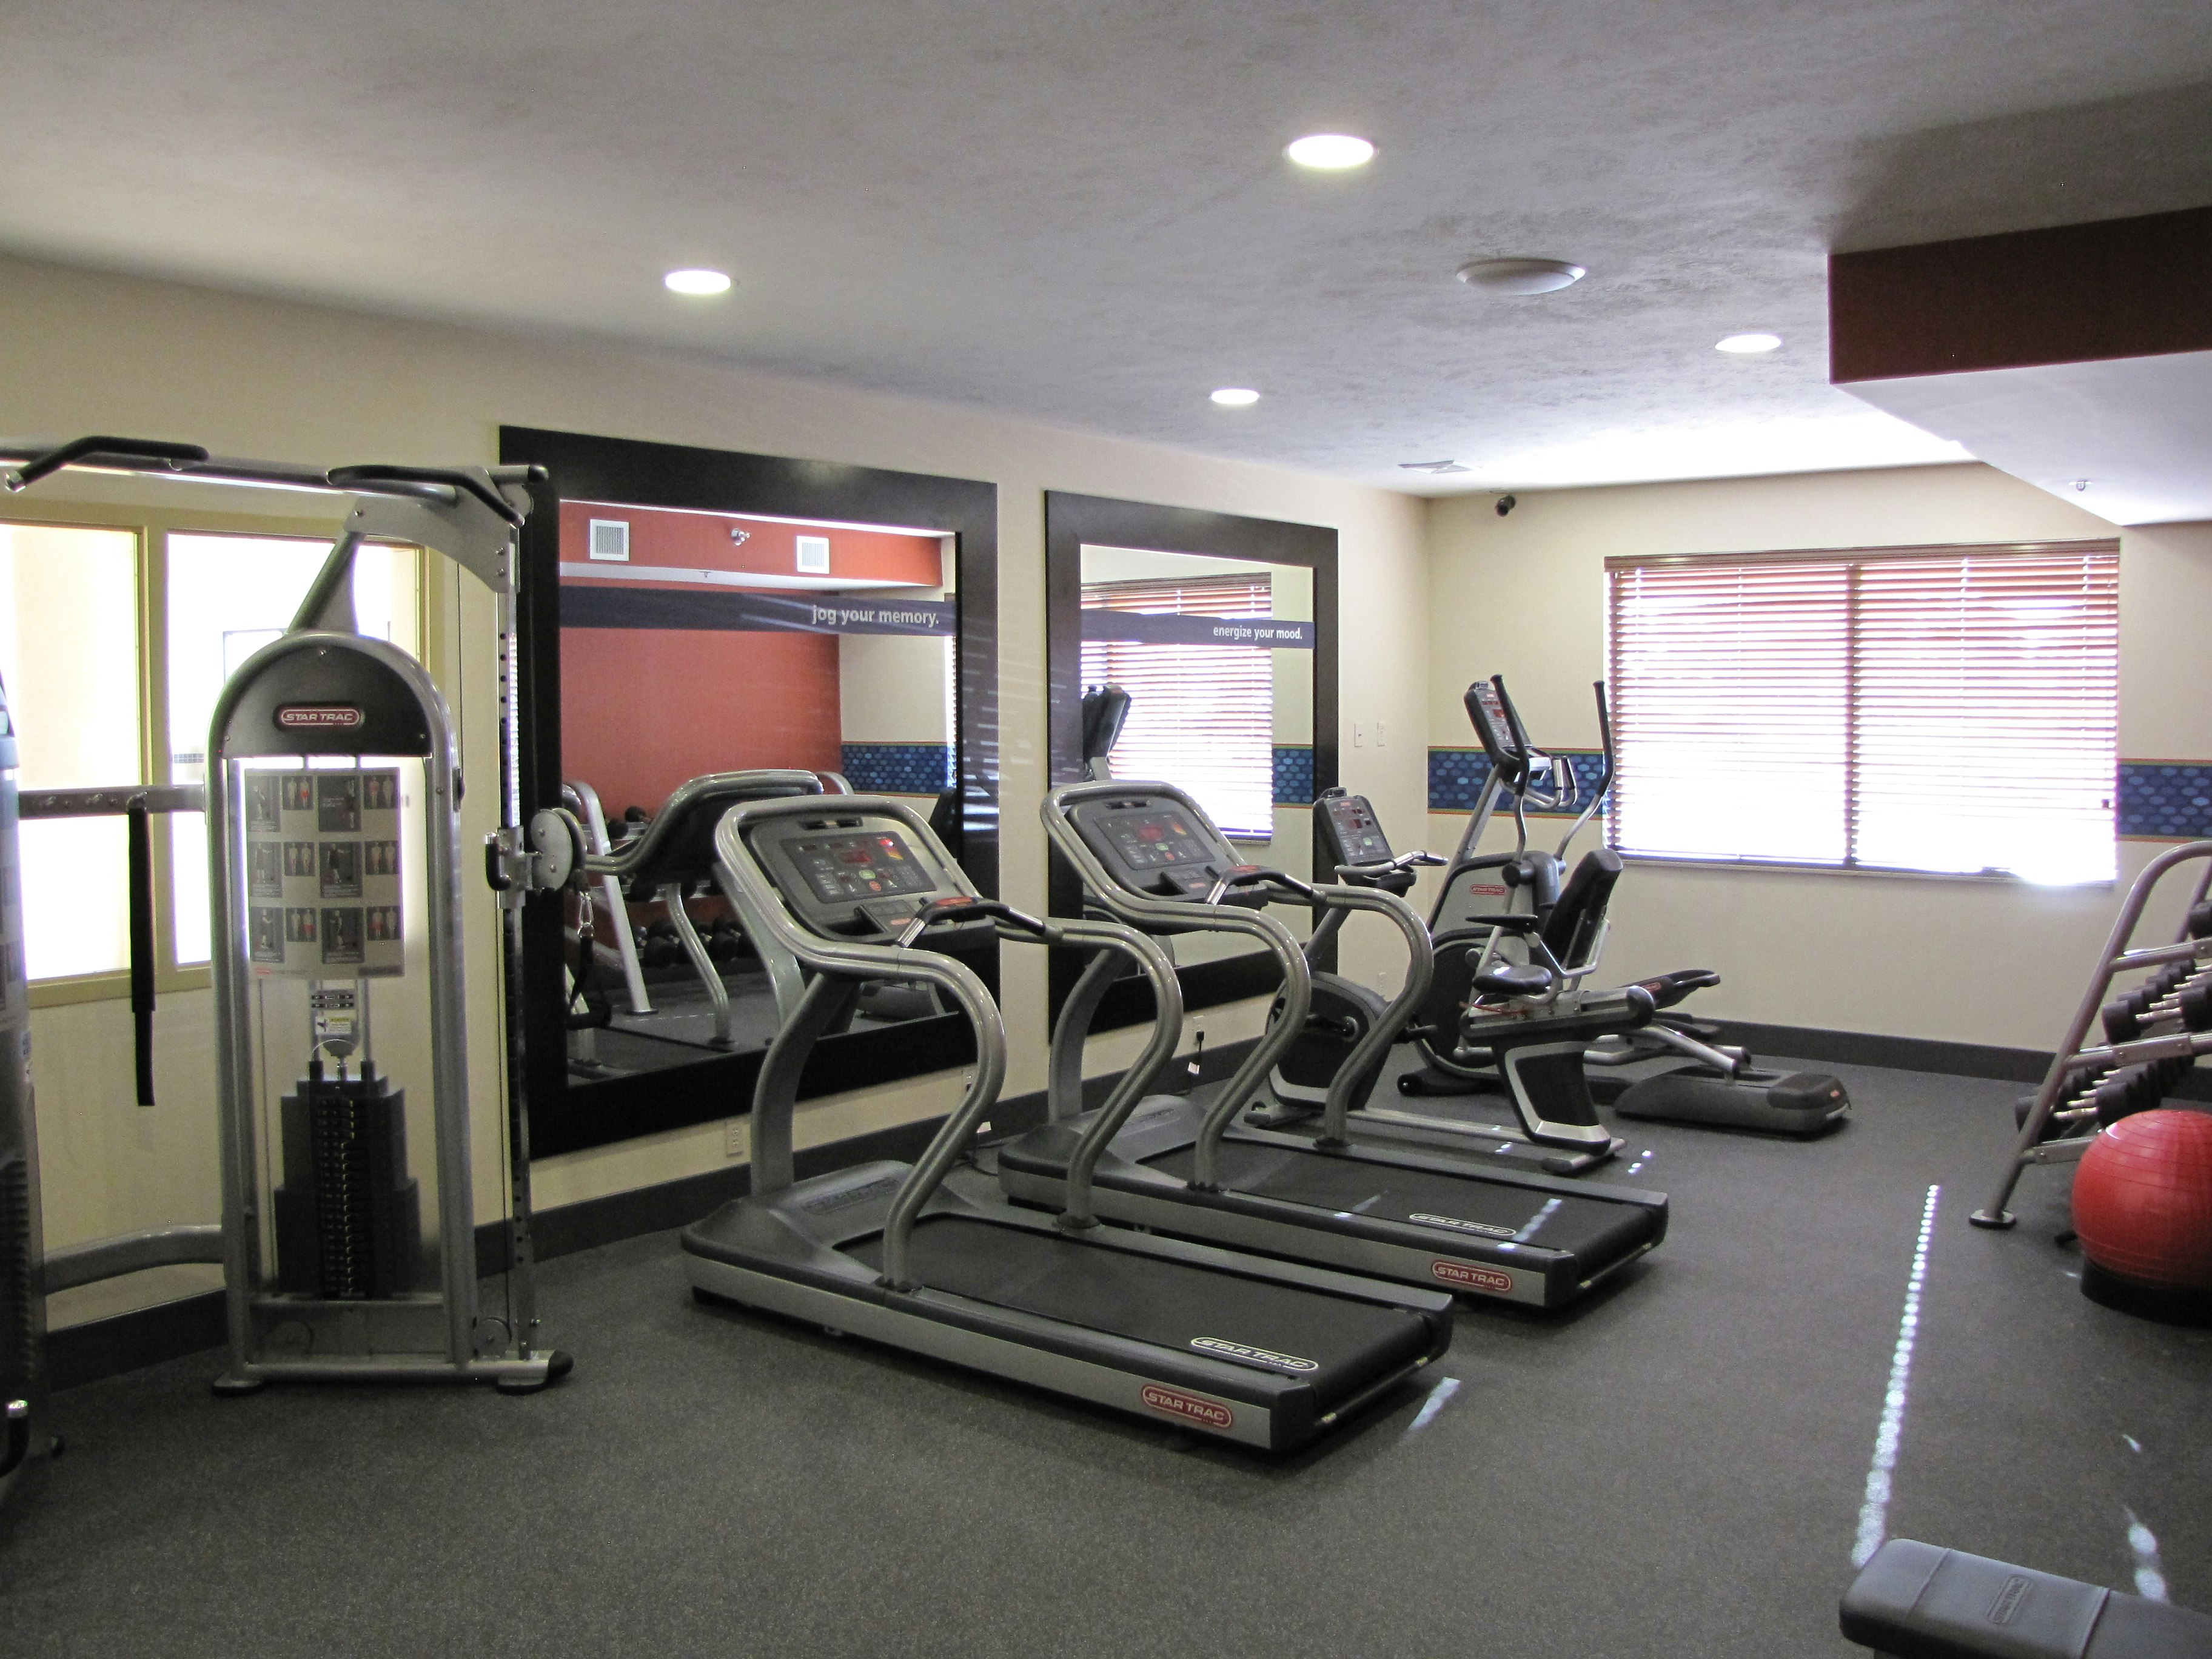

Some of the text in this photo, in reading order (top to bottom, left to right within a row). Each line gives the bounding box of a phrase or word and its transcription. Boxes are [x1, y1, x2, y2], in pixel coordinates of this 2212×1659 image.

[812, 605, 939, 628] jog your memory.
[1213, 625, 1302, 641] energize your mood.
[1435, 1266, 1505, 1286] STAR TRAC
[1197, 1339, 1309, 1367] STAR TRAC
[1146, 1392, 1224, 1421] STAR TRAC
